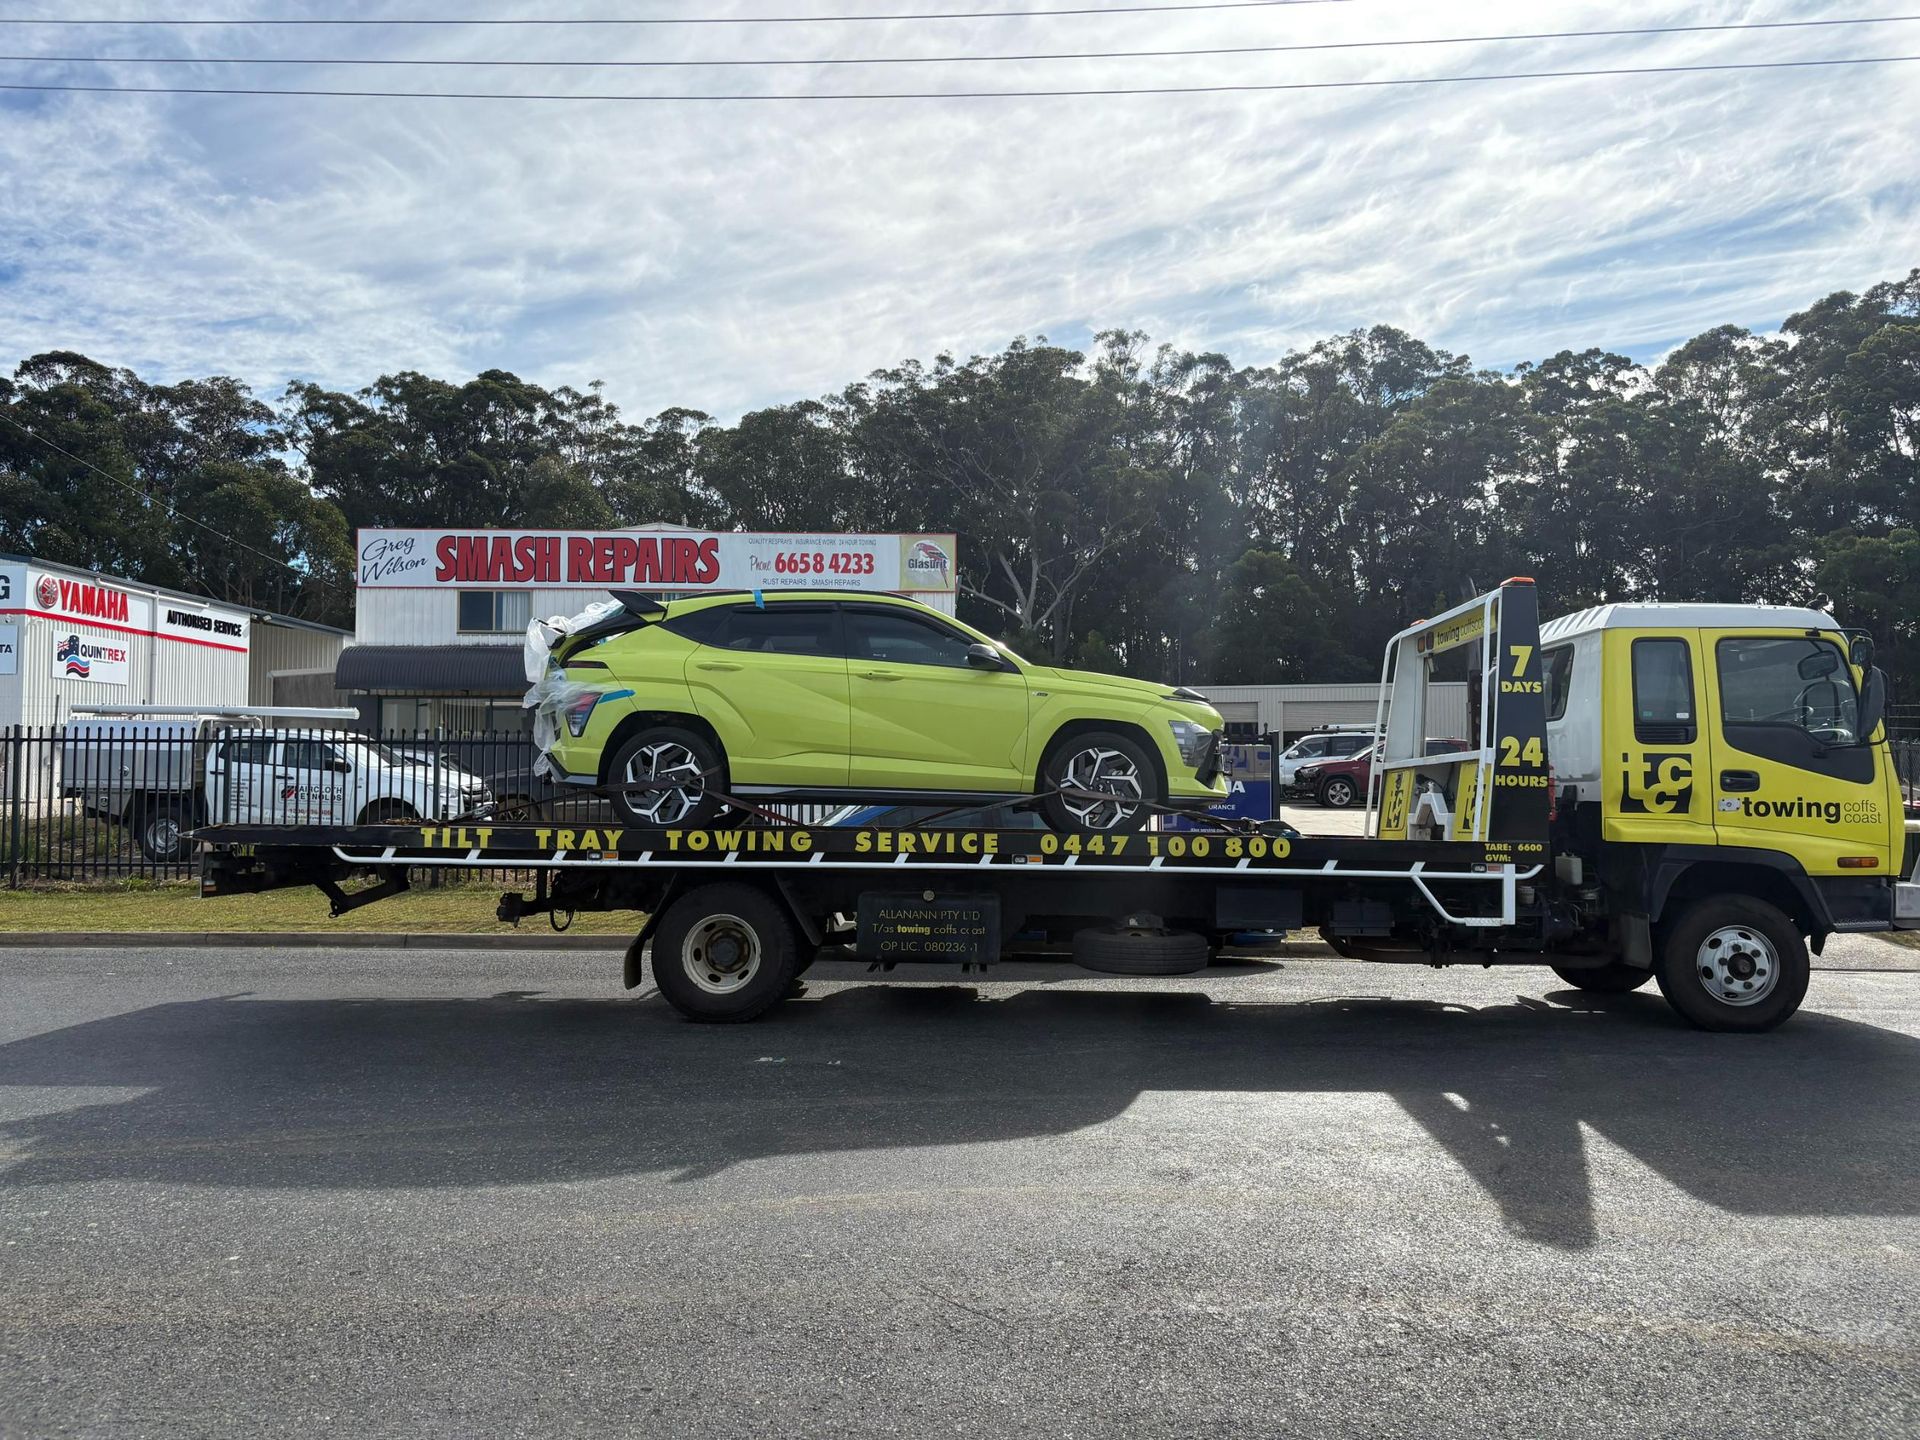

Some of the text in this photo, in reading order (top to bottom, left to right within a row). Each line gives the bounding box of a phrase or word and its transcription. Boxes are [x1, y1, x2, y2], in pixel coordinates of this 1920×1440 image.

[362, 537, 415, 561] Greg
[435, 535, 720, 583] SMASH REPAIRS
[749, 552, 875, 575] Phone 6658 4233
[908, 558, 947, 569] Glasurit
[362, 557, 428, 583] Wilson
[834, 579, 861, 587] REPAIRS
[59, 579, 129, 622] YAMAHA
[167, 609, 242, 637] AUTHORISED SERVICE
[1437, 626, 1460, 646] towing
[80, 644, 126, 662] QUINTREX
[1510, 645, 1533, 677] 7
[1501, 681, 1542, 693] DAYS
[1500, 736, 1544, 768] 24
[1495, 775, 1548, 787] HOURS
[297, 785, 342, 794] AIRCOH
[1742, 797, 1841, 824] towing
[1844, 800, 1877, 813] coffs
[1844, 812, 1882, 824] coast
[420, 827, 1291, 858] TILT TRAY TOWING SERVICE 0447 100 800
[1484, 843, 1543, 852] TARE: 6600
[1485, 854, 1512, 862] GVM:
[879, 909, 937, 919] ALLANANN
[940, 911, 960, 920] PTY
[897, 924, 931, 935] towing
[933, 924, 957, 935] coffs
[880, 941, 898, 951] OP
